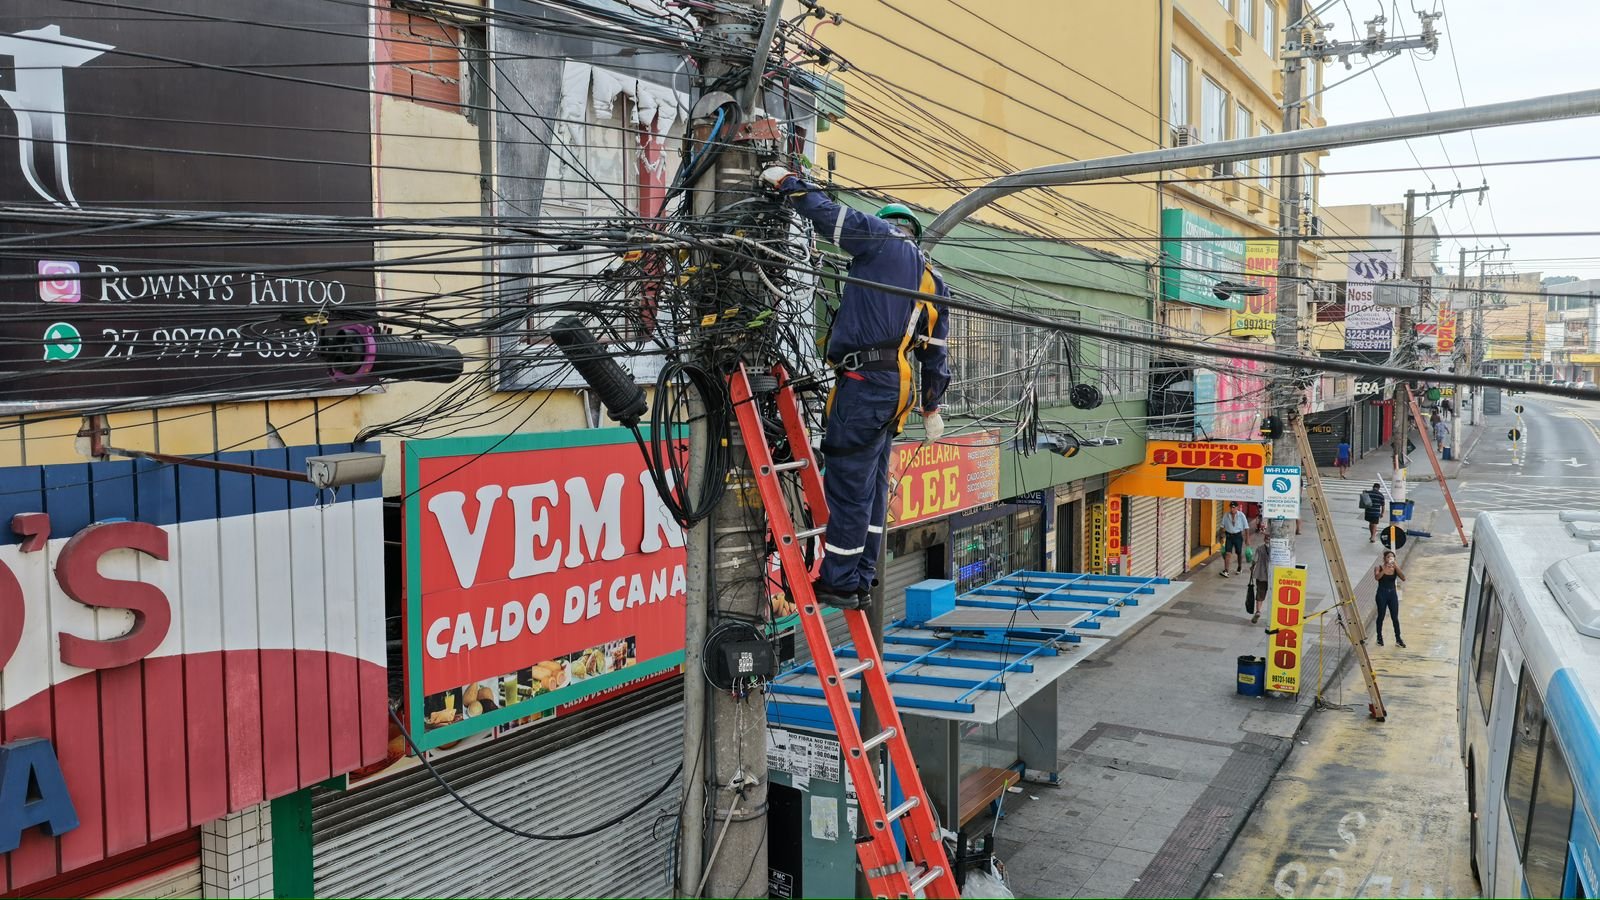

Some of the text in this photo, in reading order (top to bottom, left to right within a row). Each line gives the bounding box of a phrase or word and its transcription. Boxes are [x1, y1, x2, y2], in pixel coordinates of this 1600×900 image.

[1247, 257, 1278, 271] OMPR
[1348, 288, 1372, 301] Noss
[1346, 329, 1390, 340] 3226-6444
[1351, 340, 1390, 350] 99932-9711
[1177, 442, 1239, 451] COMPRO
[899, 442, 961, 470] PASTELARIA
[1153, 448, 1263, 470] OURO
[899, 465, 961, 521] LEE
[1214, 486, 1257, 495] VENAMORE
[427, 472, 625, 590] VEM
[1110, 501, 1120, 549] OURO
[1278, 579, 1302, 587] COMPRO
[426, 563, 687, 660] CALDO DE CANA
[1274, 586, 1301, 670] OURO
[772, 871, 786, 881] PMC
